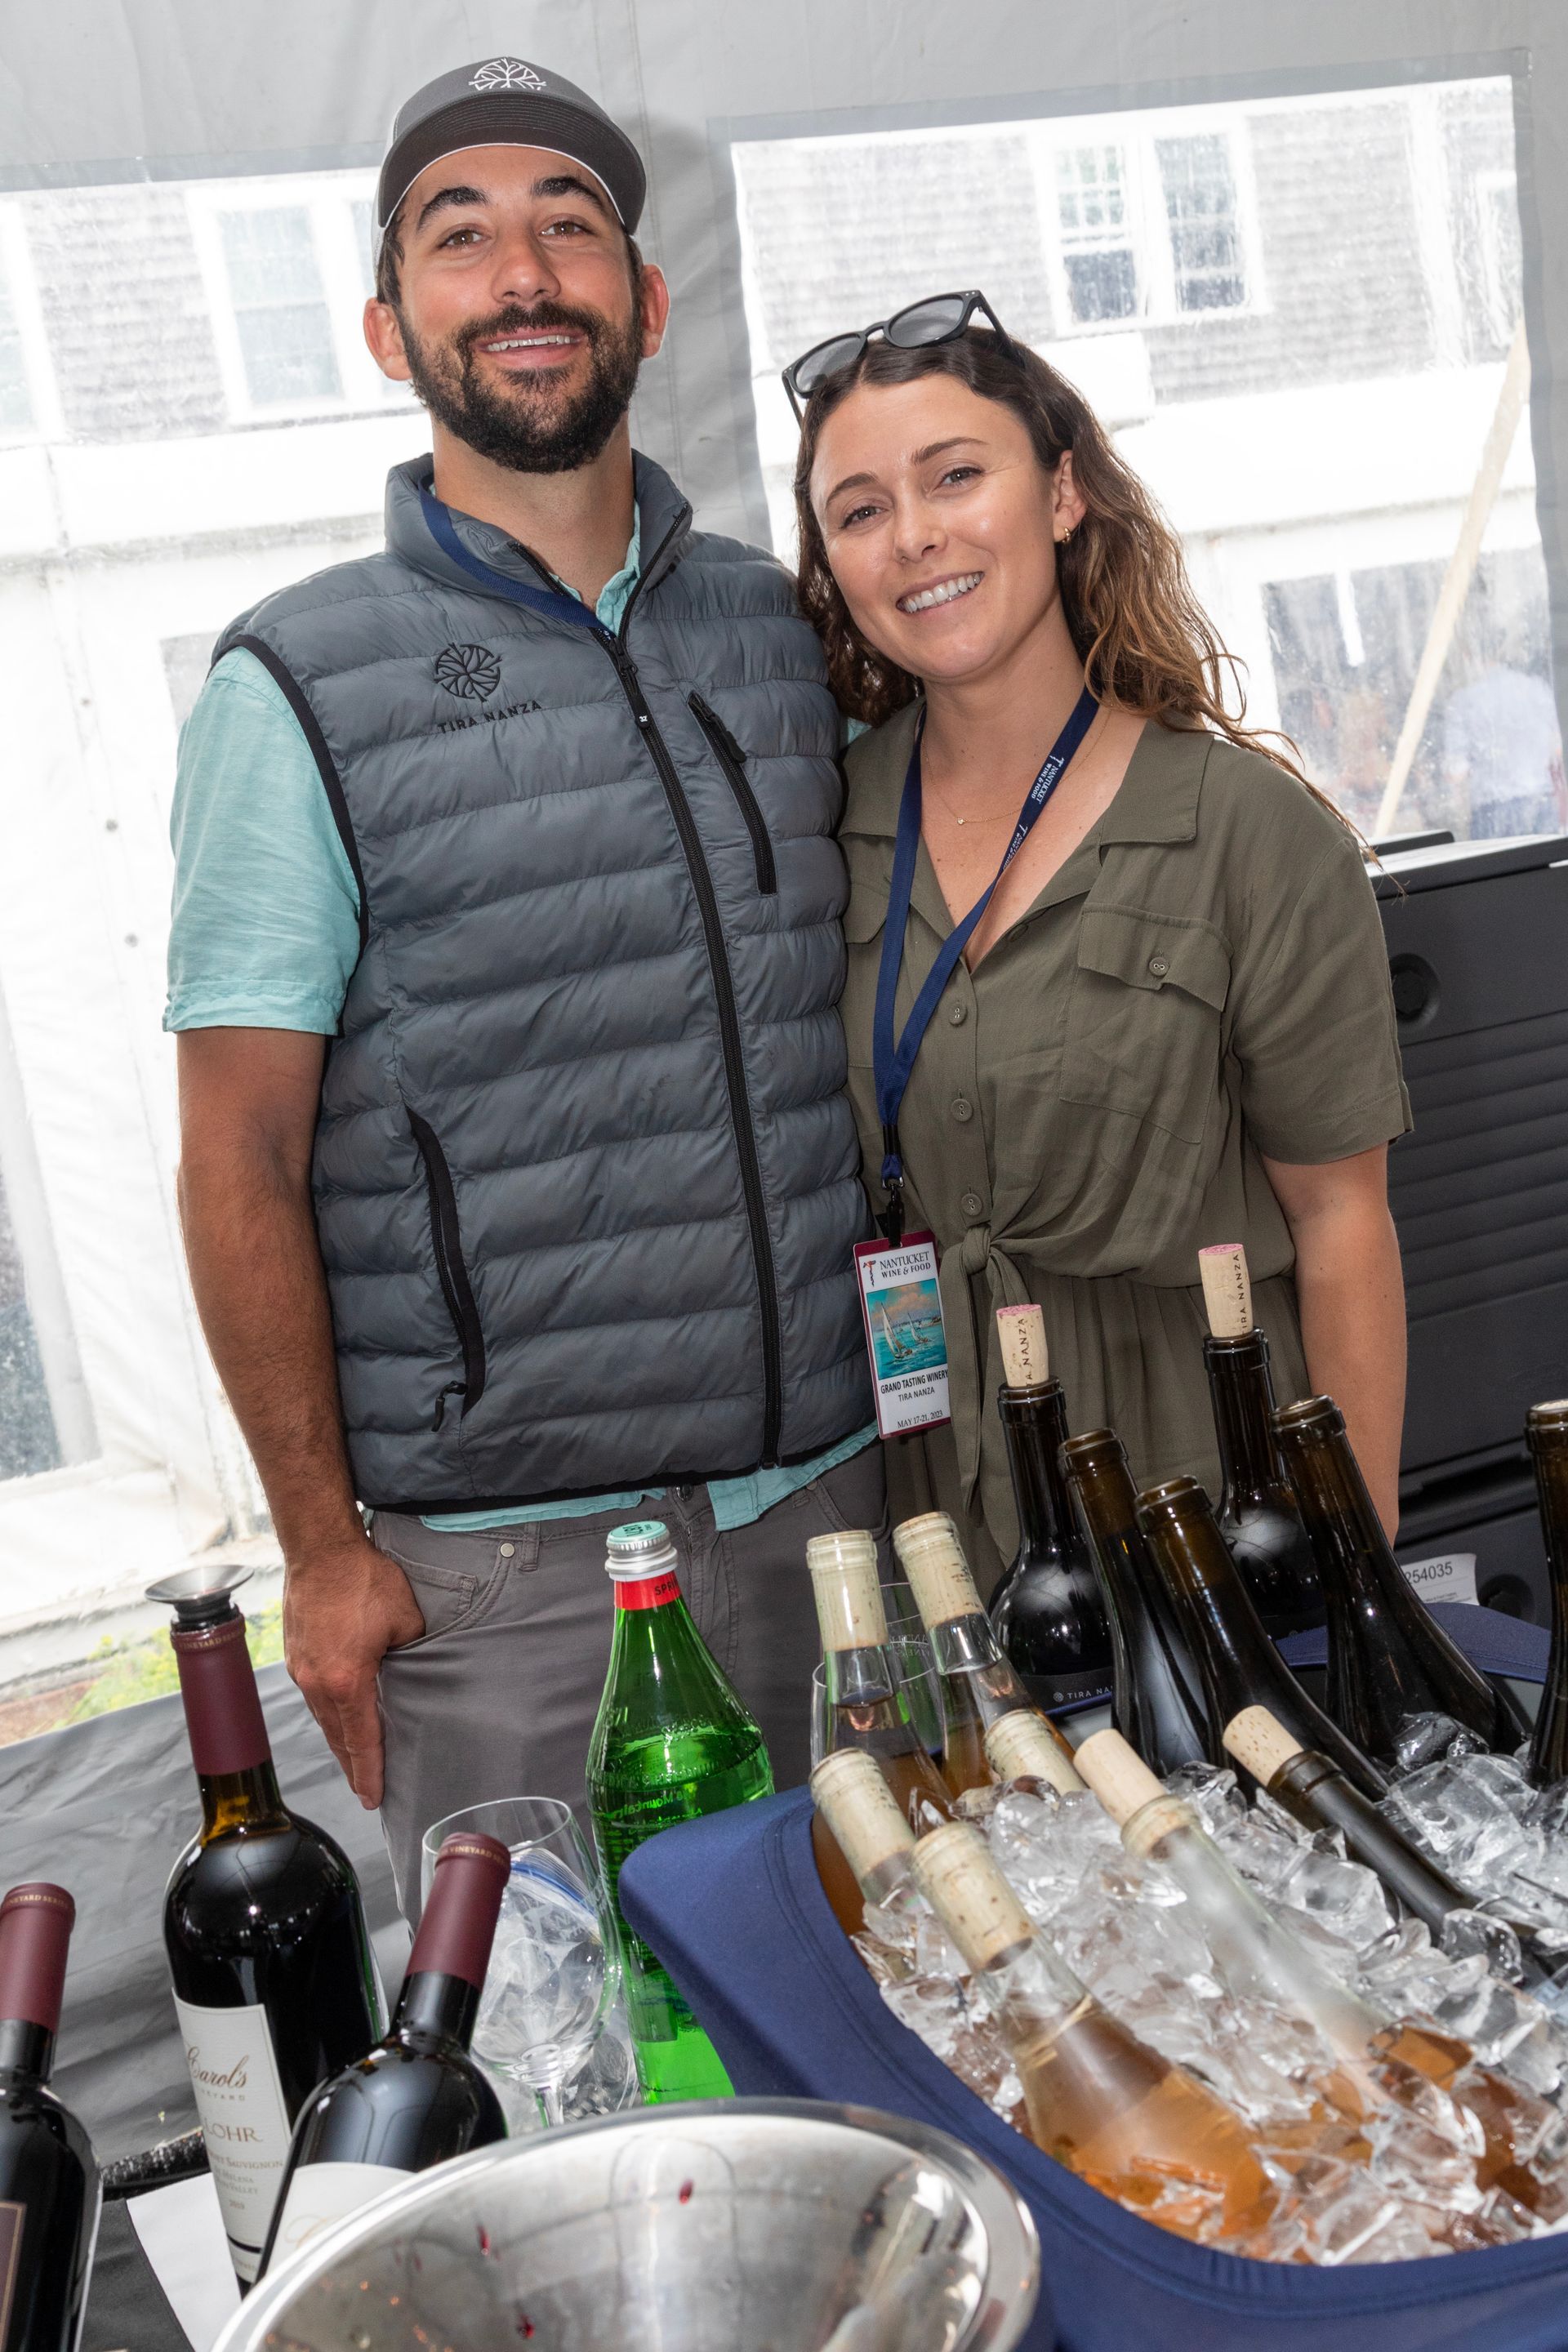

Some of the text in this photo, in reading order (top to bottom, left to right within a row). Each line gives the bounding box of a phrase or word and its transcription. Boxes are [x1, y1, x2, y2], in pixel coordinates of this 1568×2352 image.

[438, 700, 541, 734] TIRA NANZA
[1040, 763, 1052, 777] WINE
[1031, 782, 1041, 799] FOOD
[1036, 765, 1058, 804] NANTUCKET
[880, 1250, 930, 1270] NANTUCKET
[881, 1262, 931, 1279] WINE & FOOD
[1233, 1254, 1248, 1337] IRA NANZA
[1018, 1318, 1031, 1365] NANZA
[880, 1369, 948, 1394] GRAND TASTING WINERY
[898, 1387, 935, 1402] TIRA NANZA
[898, 1410, 943, 1429] MAY 17-21, 2023
[1067, 1690, 1092, 1699] TIRA
